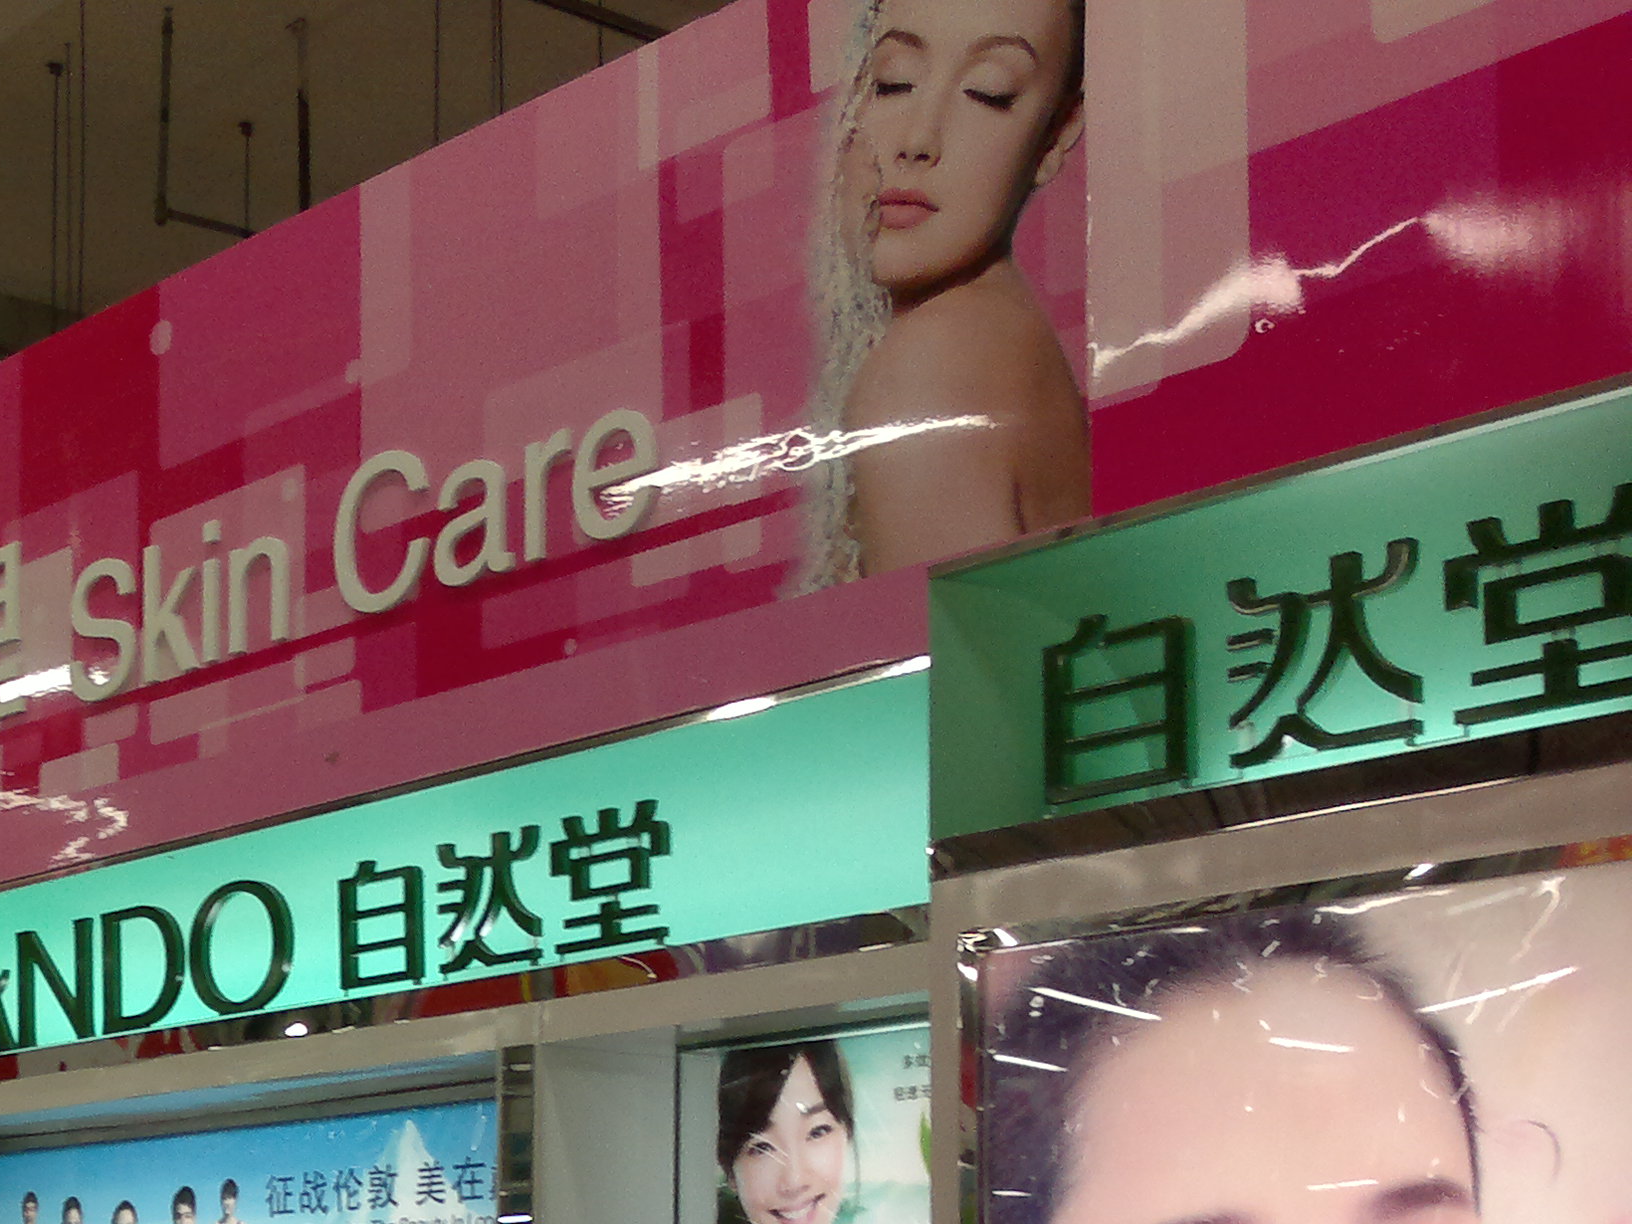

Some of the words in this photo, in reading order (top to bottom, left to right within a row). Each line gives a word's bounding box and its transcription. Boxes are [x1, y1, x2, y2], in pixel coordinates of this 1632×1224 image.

[68, 519, 290, 703] Skin
[333, 407, 662, 614] Care
[1042, 482, 1632, 804] 自然堂
[336, 798, 671, 997] 自然堂
[265, 1164, 399, 1218] 征战伦敦
